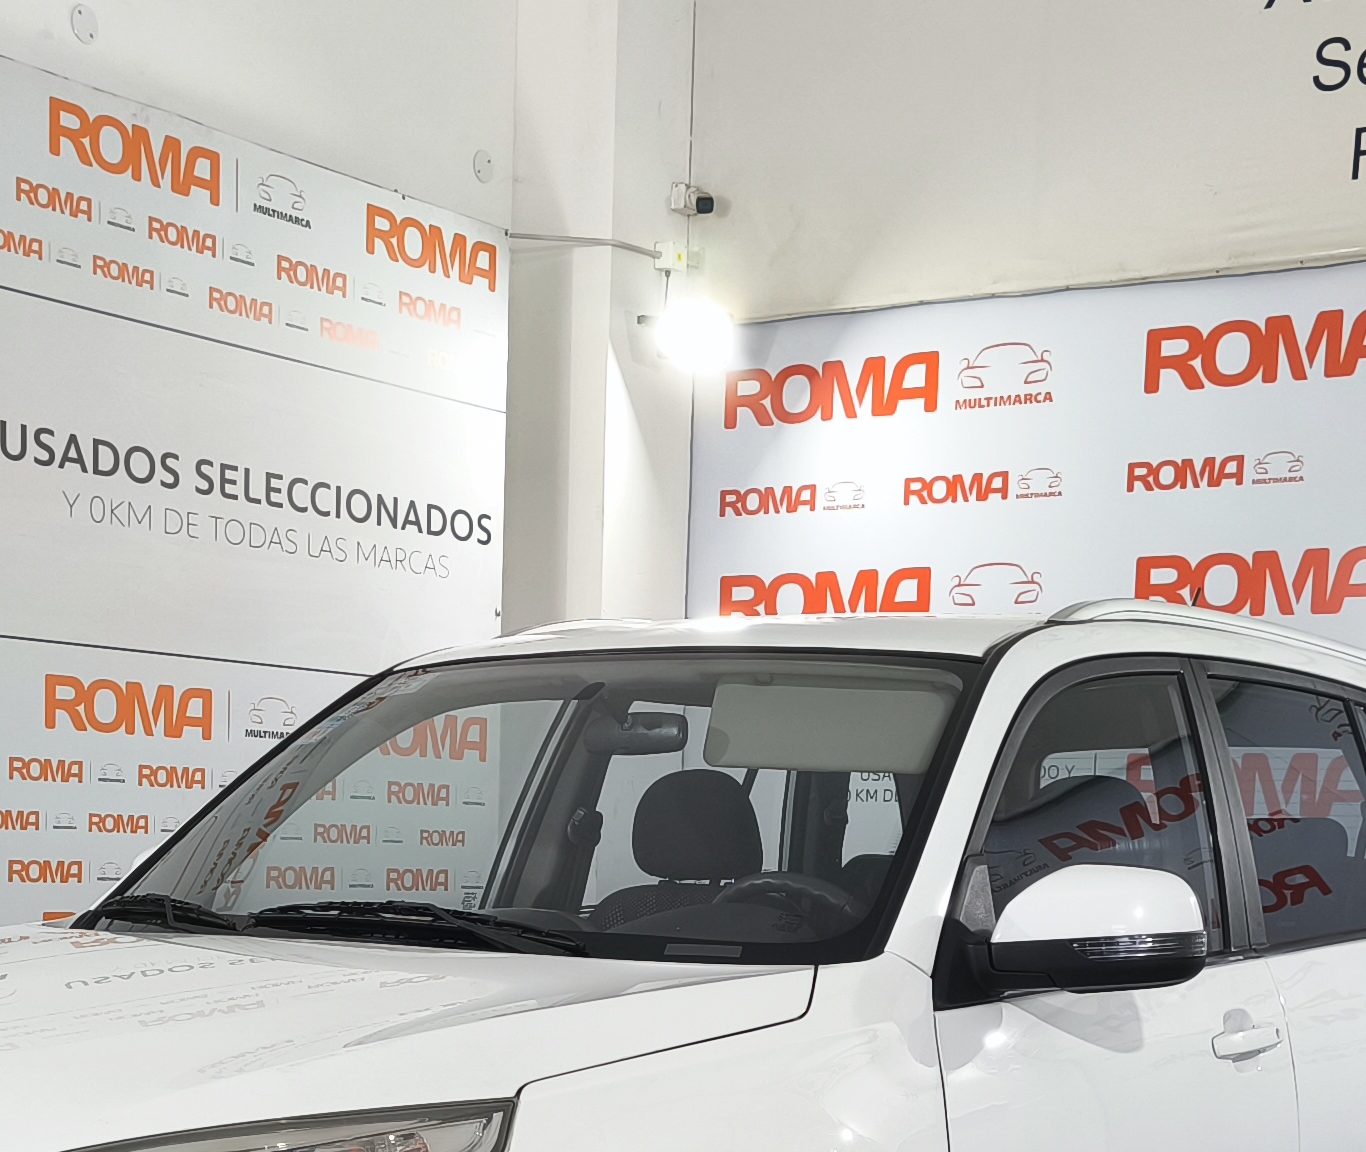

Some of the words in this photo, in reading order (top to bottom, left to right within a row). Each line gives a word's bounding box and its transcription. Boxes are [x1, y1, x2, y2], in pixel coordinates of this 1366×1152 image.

[49, 98, 220, 206] ROMA
[17, 179, 91, 221] ROMA
[253, 203, 311, 229] MULTIMARCA
[149, 218, 216, 256] ROMA
[367, 205, 497, 292] ROMA
[93, 257, 154, 288] ROMA
[277, 257, 347, 296] ROMA
[209, 289, 272, 322] ROMA
[725, 352, 939, 430] ROMA
[955, 391, 1053, 410] MULTIMARCA
[0, 420, 179, 489] USADOS
[195, 459, 491, 545] SELECCIONADOS
[904, 472, 1009, 506] ROMA
[1127, 456, 1245, 492] ROMA
[1252, 474, 1304, 485] MULTIMARCA
[721, 485, 816, 517] ROMA
[63, 491, 80, 517] Y
[165, 508, 198, 539] DE
[208, 516, 297, 554] TODAS
[306, 534, 347, 562] LAS
[357, 541, 450, 579] MARCAS
[720, 568, 931, 616] ROMA
[45, 675, 213, 741] ROMA
[377, 715, 488, 762] OMA
[9, 759, 83, 783] ROMA
[139, 766, 205, 789] ROMA
[387, 781, 450, 807] ROMA
[856, 788, 878, 803] KM
[89, 815, 149, 834] ROMA
[313, 823, 371, 845] ROMA
[419, 829, 466, 848] ROMA
[9, 861, 83, 884] ROMA
[265, 866, 335, 891] ROMA
[385, 868, 449, 892] ROMA
